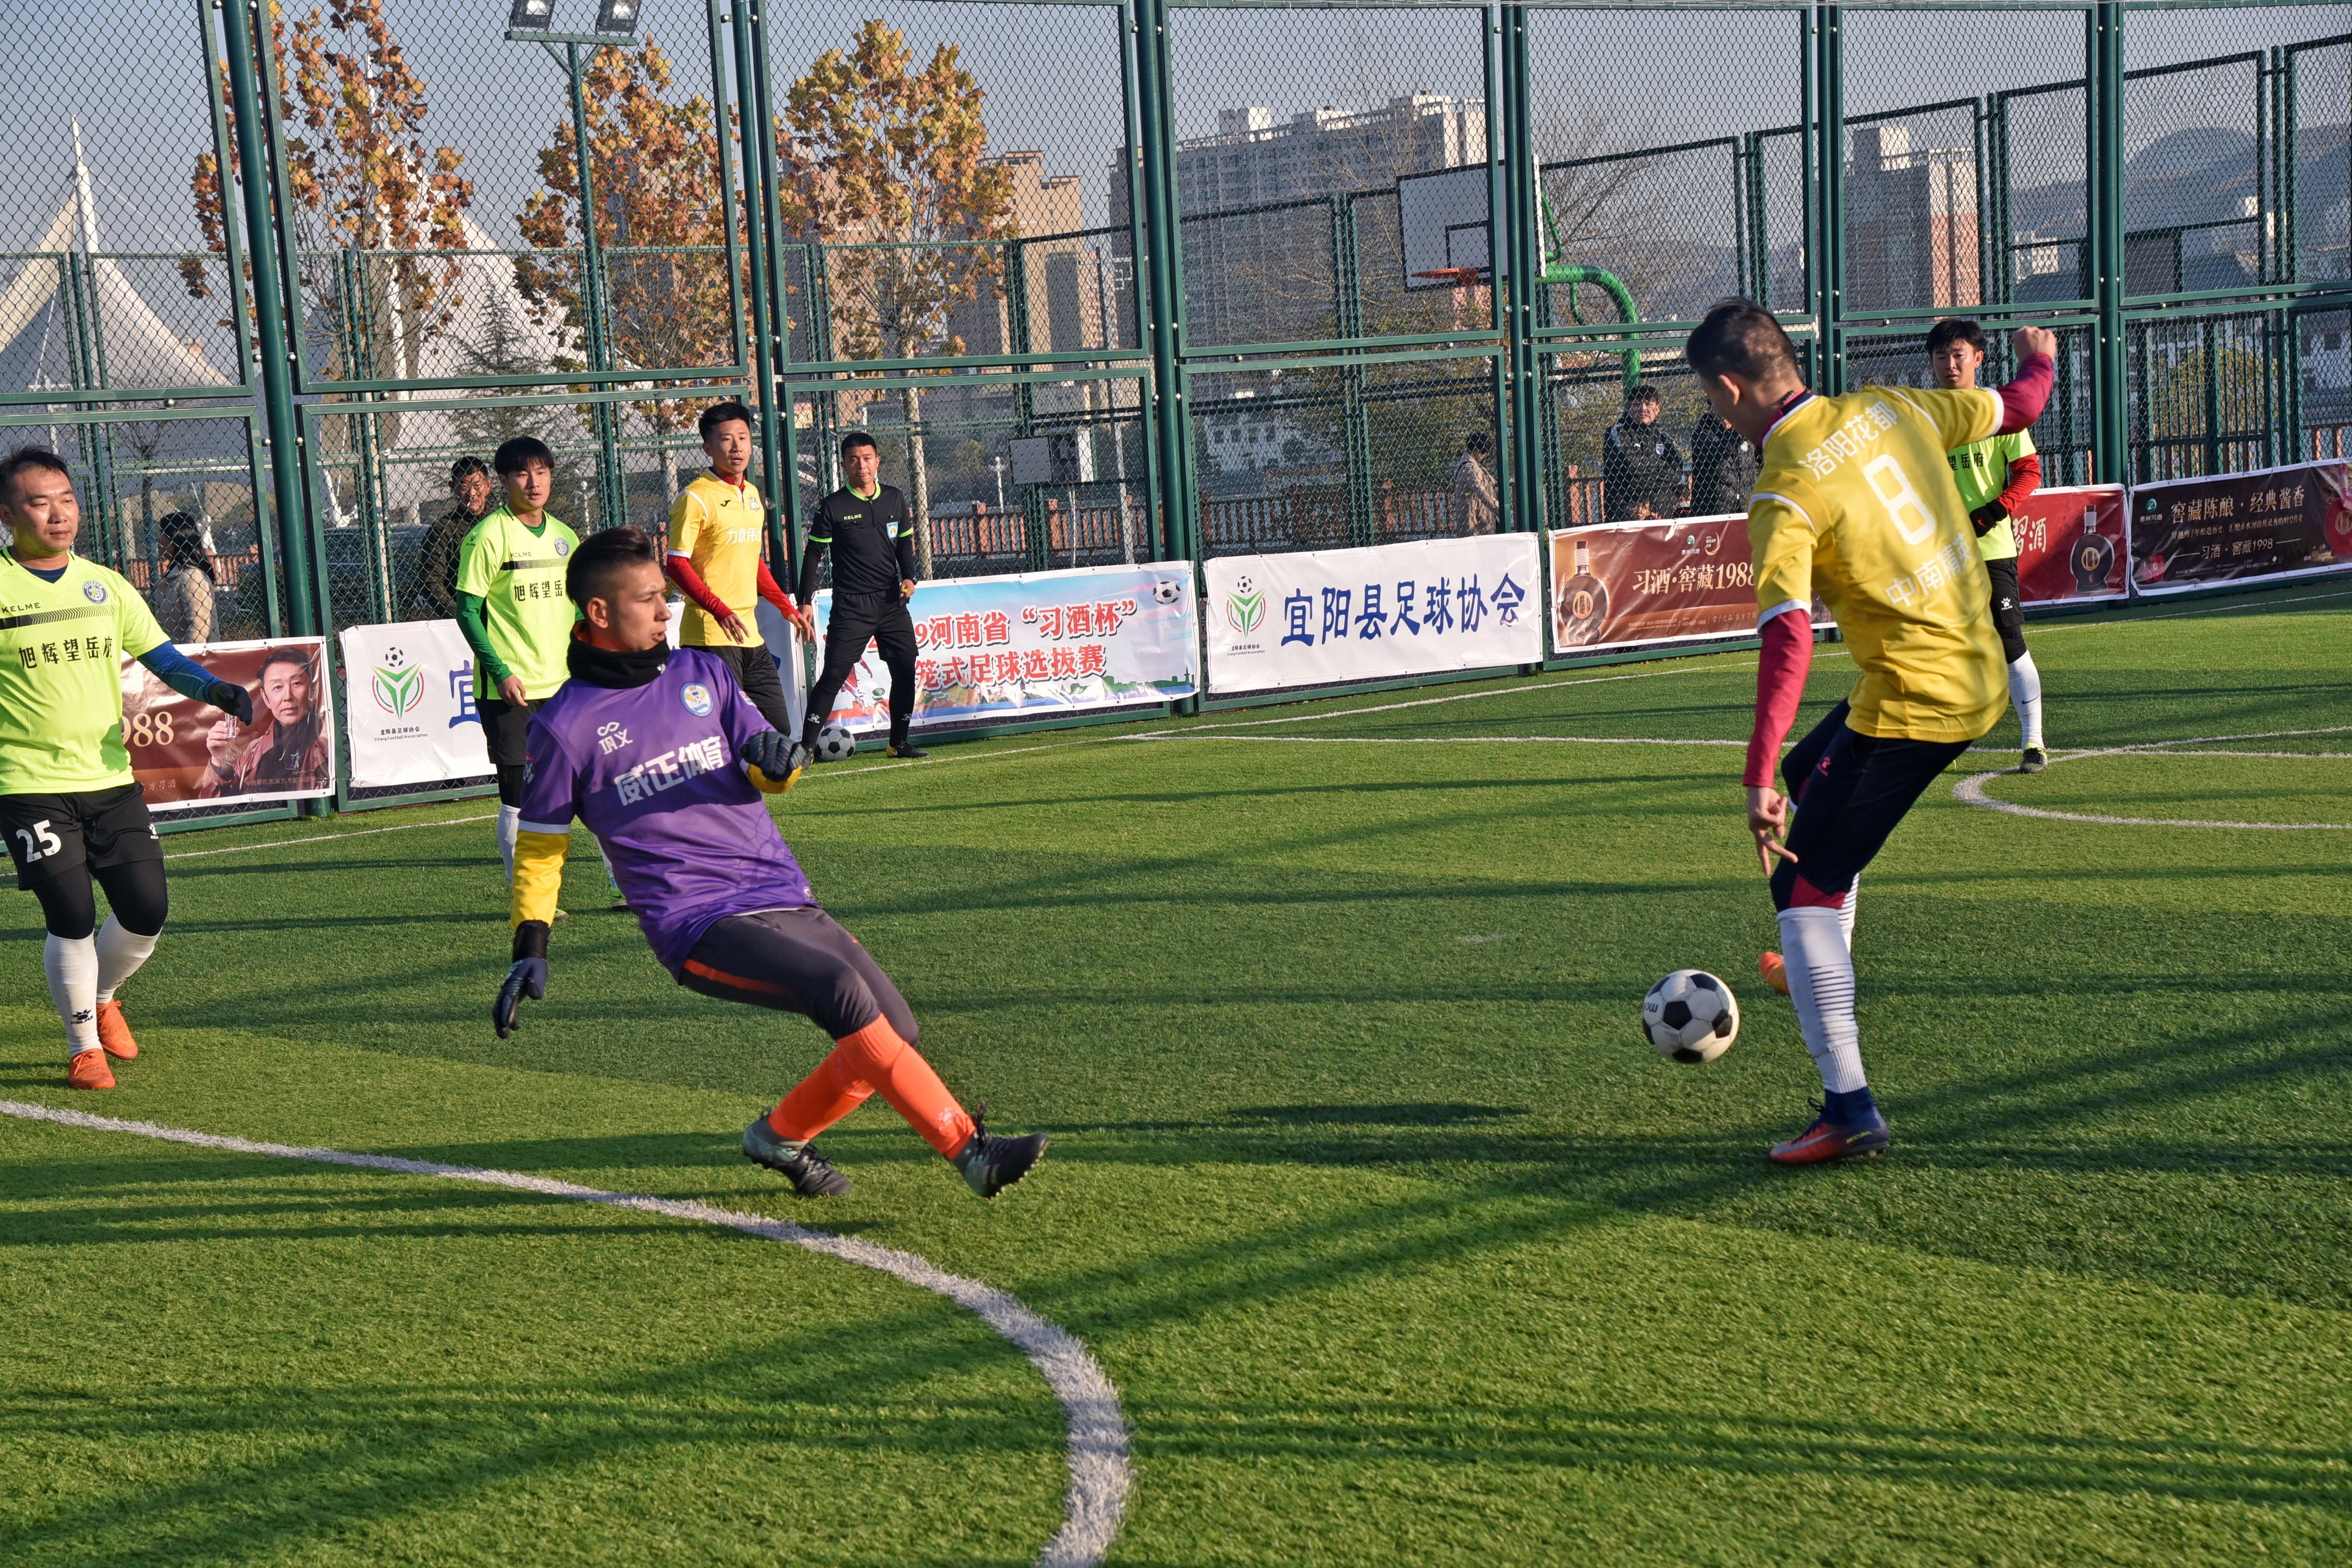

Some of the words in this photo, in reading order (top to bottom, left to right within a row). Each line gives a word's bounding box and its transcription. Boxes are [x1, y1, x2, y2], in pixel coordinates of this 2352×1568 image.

[1798, 401, 1897, 481] 洛阳花都
[1863, 454, 1936, 545] 8
[513, 580, 563, 602] 旭辉望岳
[1885, 532, 1972, 607] 中南精英
[2, 602, 41, 614] KELME
[1281, 572, 1525, 647] 宜阳县足球协会
[915, 644, 1104, 690] 笼式足球选拔赛
[381, 726, 420, 736] 宜阳县足球协会
[598, 729, 633, 755] 巩义
[614, 736, 725, 806] 威正体育
[16, 819, 62, 863] 25
